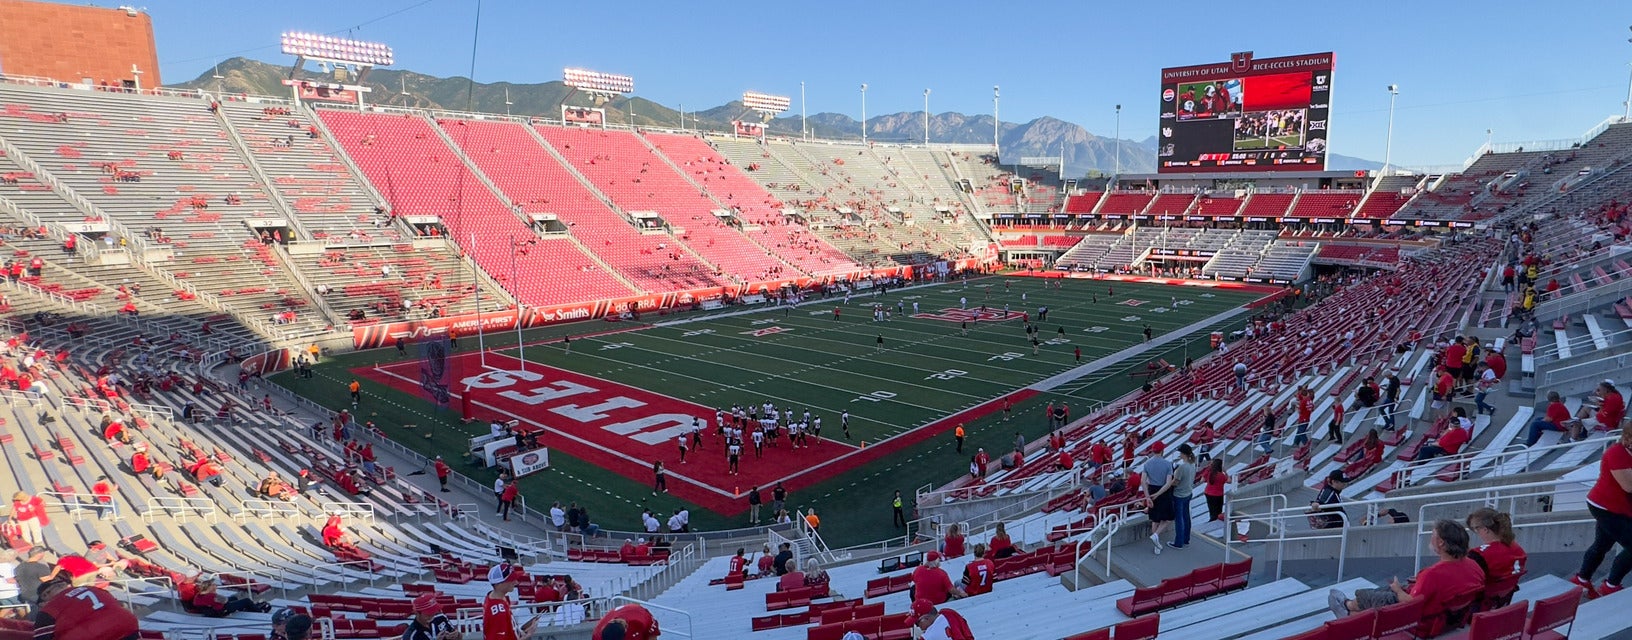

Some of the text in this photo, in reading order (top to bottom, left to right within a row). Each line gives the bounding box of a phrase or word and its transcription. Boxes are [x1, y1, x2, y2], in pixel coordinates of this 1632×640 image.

[1231, 51, 1253, 72] U
[1253, 57, 1329, 70] RICE-ECCLES STADIUM
[1164, 70, 1199, 79] UNIVERSITY
[1211, 67, 1229, 75] UTAH
[490, 315, 513, 324] FIRST
[556, 306, 590, 321] Smith's
[460, 370, 708, 446] UTES
[730, 561, 737, 572] 11
[979, 570, 988, 586] 7
[76, 590, 104, 610] 7
